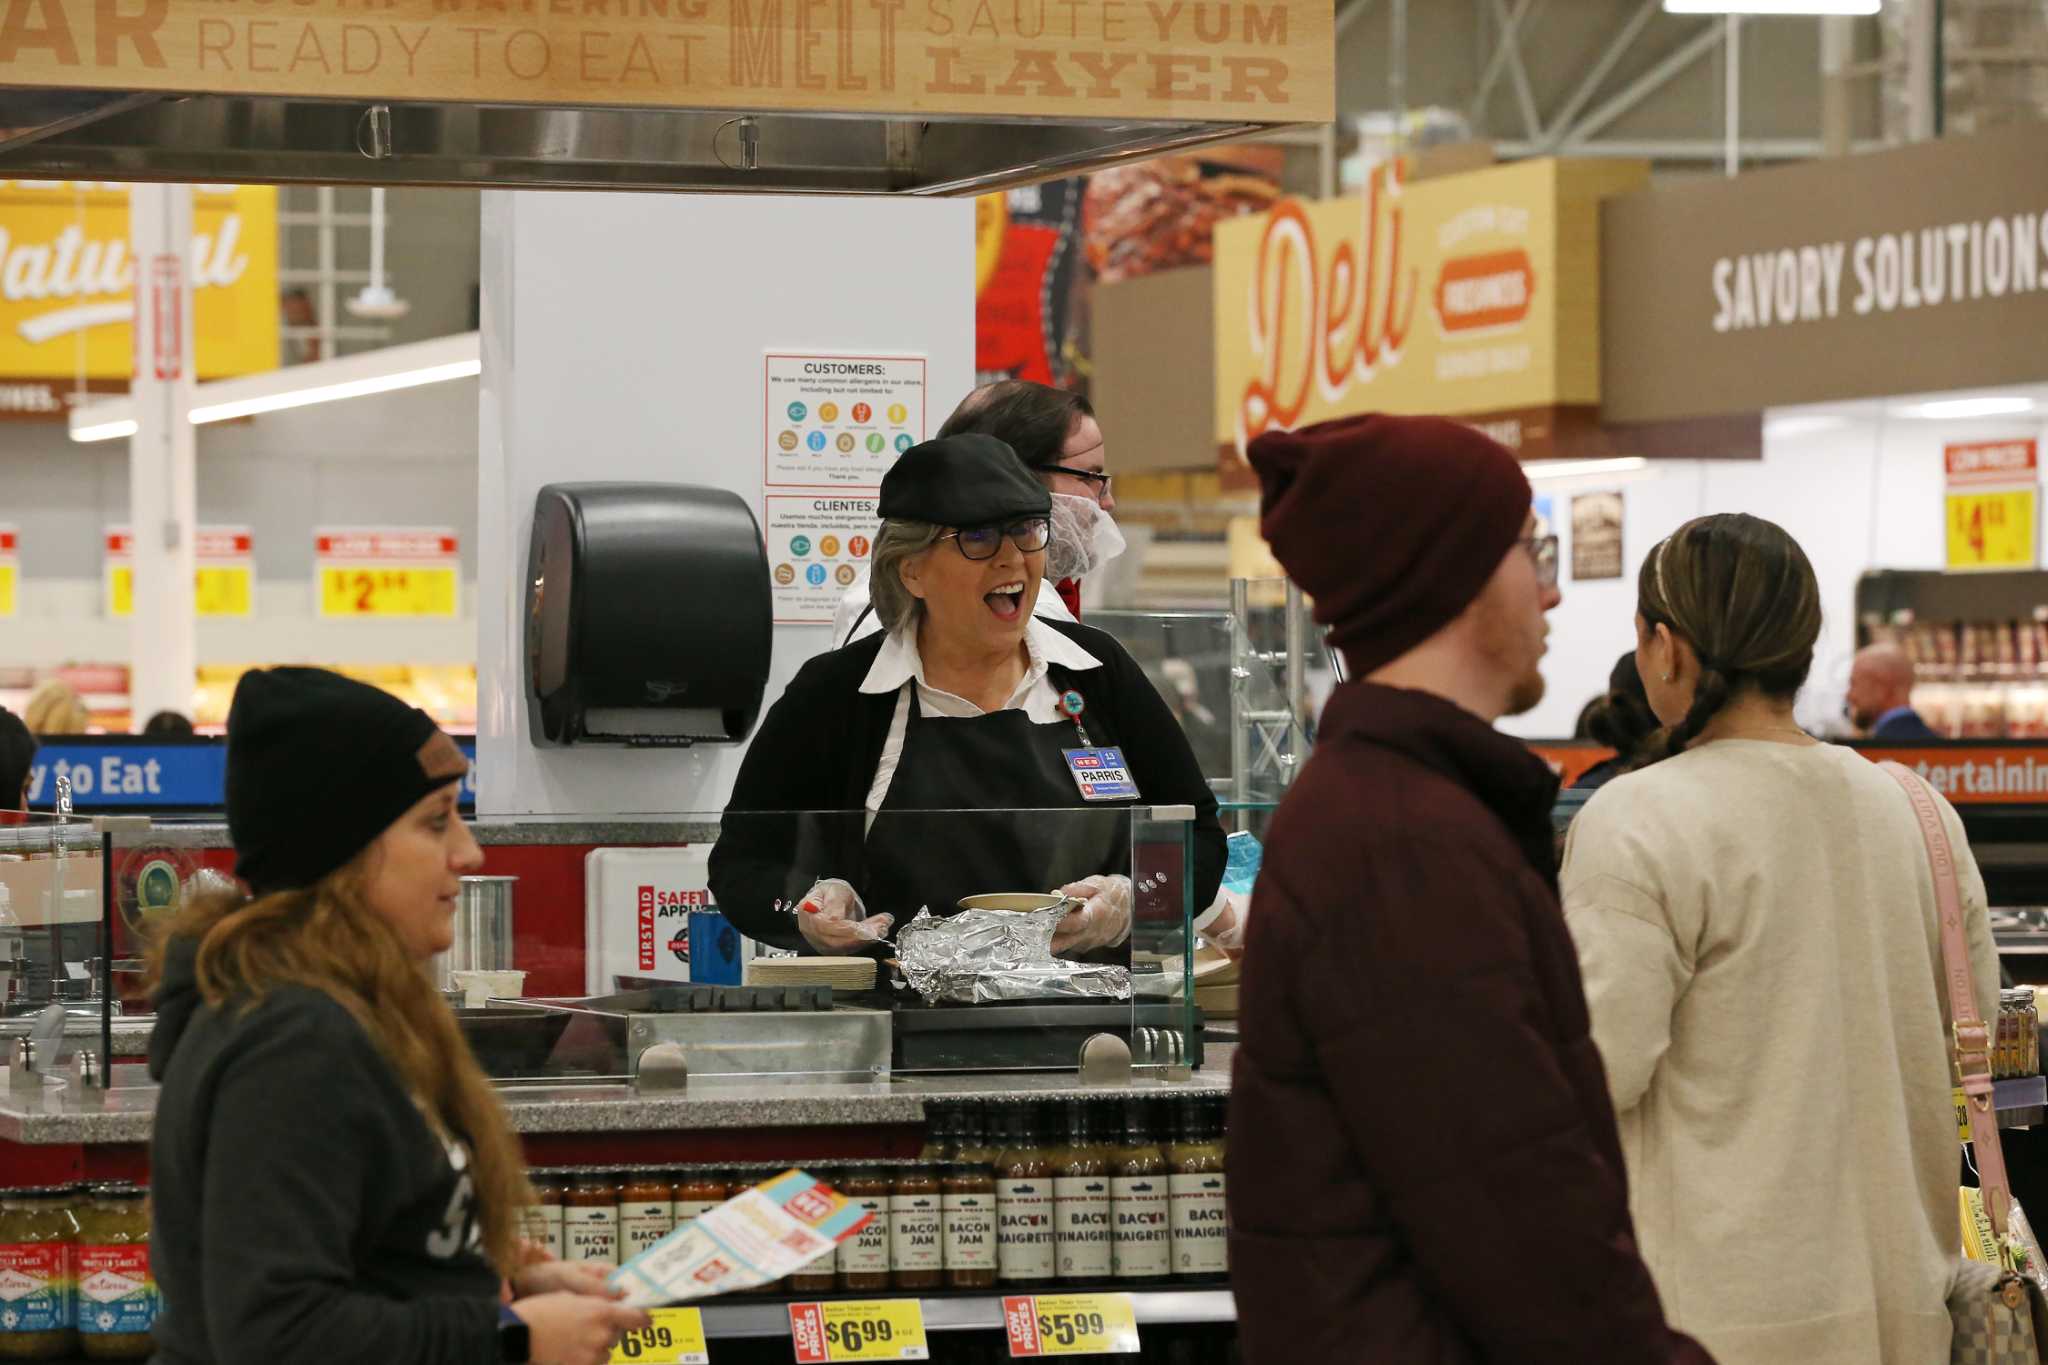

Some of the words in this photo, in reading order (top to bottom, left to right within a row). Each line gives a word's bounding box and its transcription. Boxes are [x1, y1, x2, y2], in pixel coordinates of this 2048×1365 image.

[1147, 0, 1291, 45] YUM
[200, 20, 431, 76] READY
[456, 27, 551, 81] TO
[579, 31, 706, 84] EAT
[729, 0, 898, 91] MELT
[924, 46, 1290, 103] LAYER
[1711, 241, 1847, 333] SAVORY
[1236, 158, 1419, 460] Deli
[803, 363, 887, 376] CUSTOMERS:
[813, 500, 876, 512] CLIENTES:
[101, 757, 161, 794] Eat
[1081, 770, 1125, 782] PARRIS
[1911, 757, 2048, 794] tertainin
[641, 891, 653, 918] AID
[641, 921, 653, 965] FIRST
[1953, 969, 1971, 1022] UITTON
[1956, 1104, 1969, 1127] 28
[948, 1222, 991, 1234] BACON
[1071, 1212, 1109, 1225] BAC
[1188, 1208, 1225, 1221] BAC
[631, 1231, 670, 1242] BAC
[857, 1237, 882, 1248] JAM
[910, 1236, 935, 1246] JAM
[957, 1235, 984, 1245] JAM
[584, 1247, 609, 1259] JAM
[795, 1317, 809, 1350] LOW
[805, 1309, 822, 1357] PRICES
[1008, 1311, 1023, 1343] LOW
[1018, 1302, 1035, 1350] PRICES
[620, 1327, 673, 1358] 699
